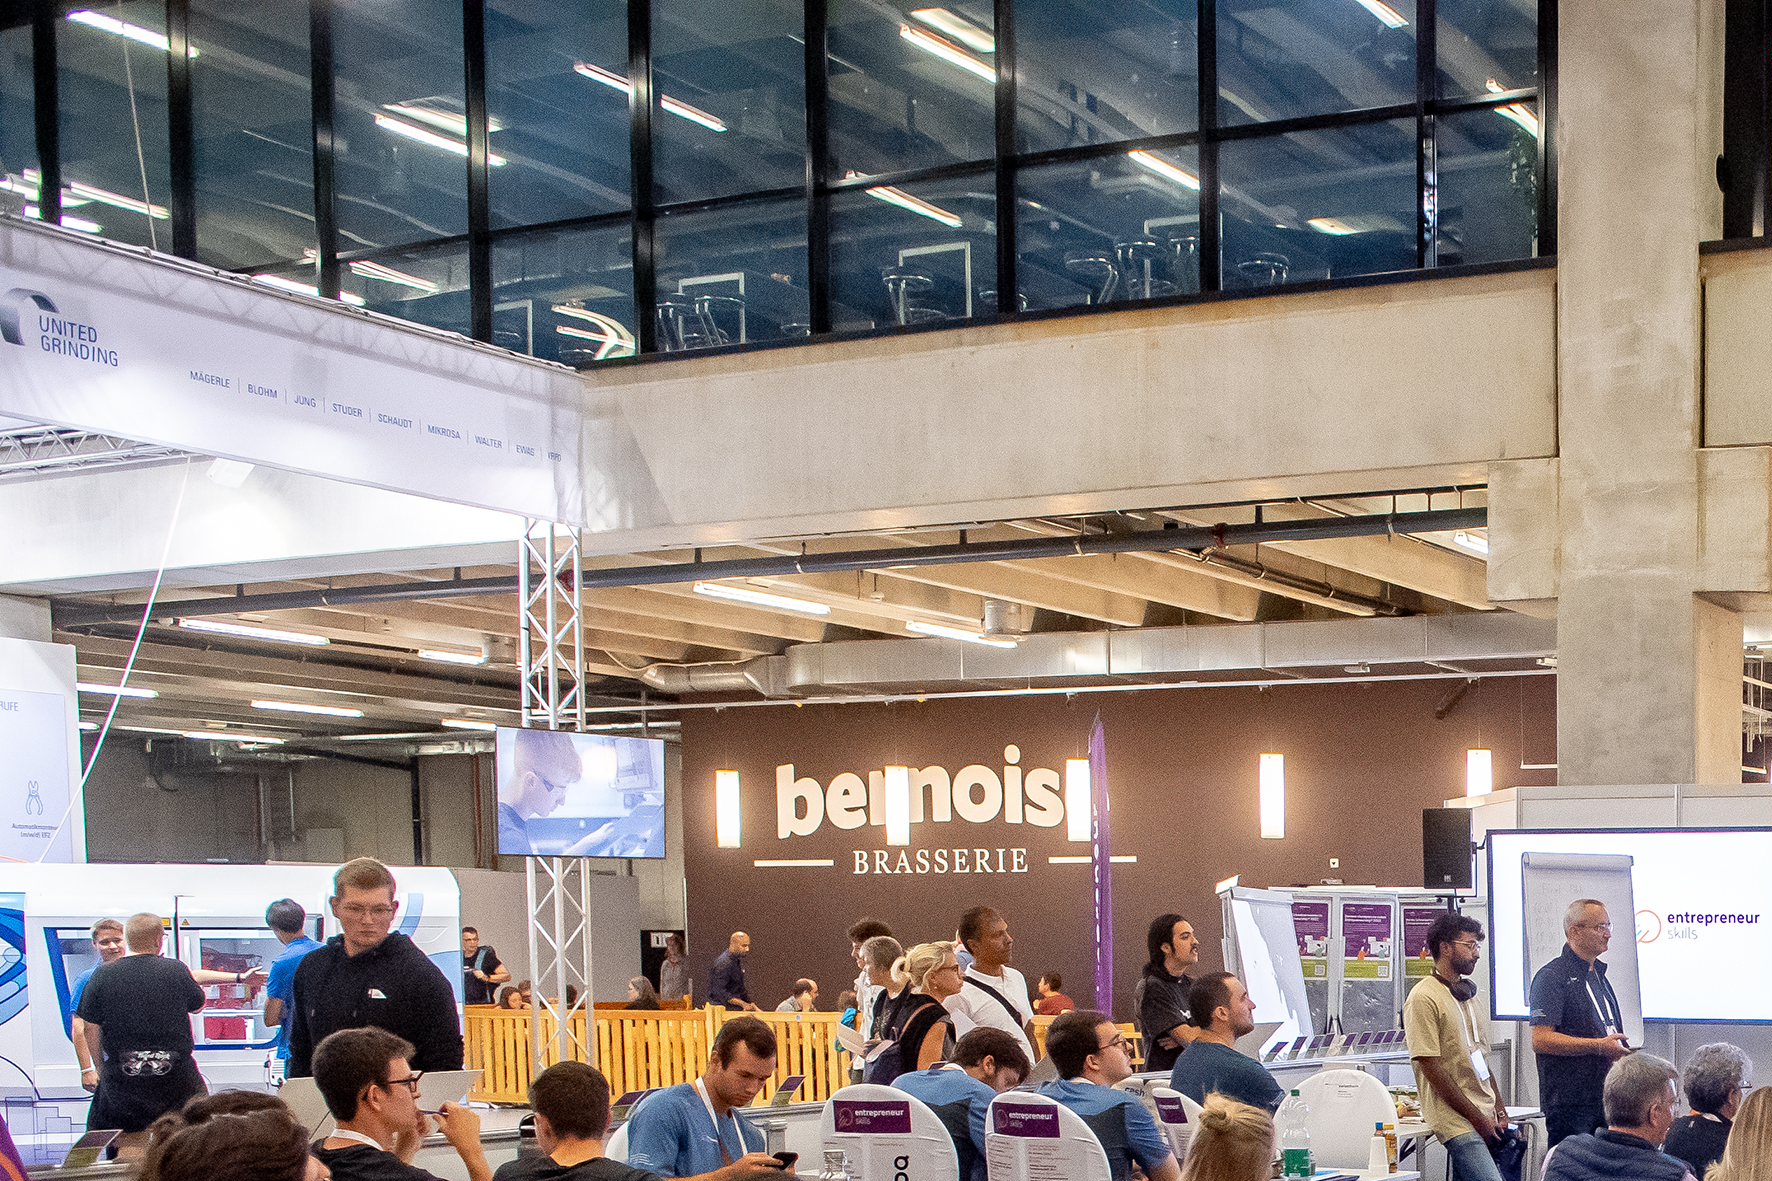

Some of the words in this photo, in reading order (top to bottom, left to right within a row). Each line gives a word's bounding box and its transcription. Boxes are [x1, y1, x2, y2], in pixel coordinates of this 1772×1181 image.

[38, 315, 98, 343] UNITED
[40, 335, 118, 367] GRINDING
[189, 370, 230, 389] MÄGERLE
[247, 383, 278, 399] BLOHM
[294, 394, 317, 408] JUNG
[332, 403, 363, 418] STUDER
[377, 413, 413, 429] SCHAUDT
[427, 424, 461, 440] MIKROSA
[474, 435, 503, 449] WALTER
[776, 744, 1066, 840] bernois
[852, 848, 1029, 875] BRASSERIE
[1667, 911, 1760, 926] entrepreneur
[1667, 927, 1698, 940] skills
[855, 1109, 904, 1117] entrepreneur
[1009, 1112, 1054, 1121] entrepreneur
